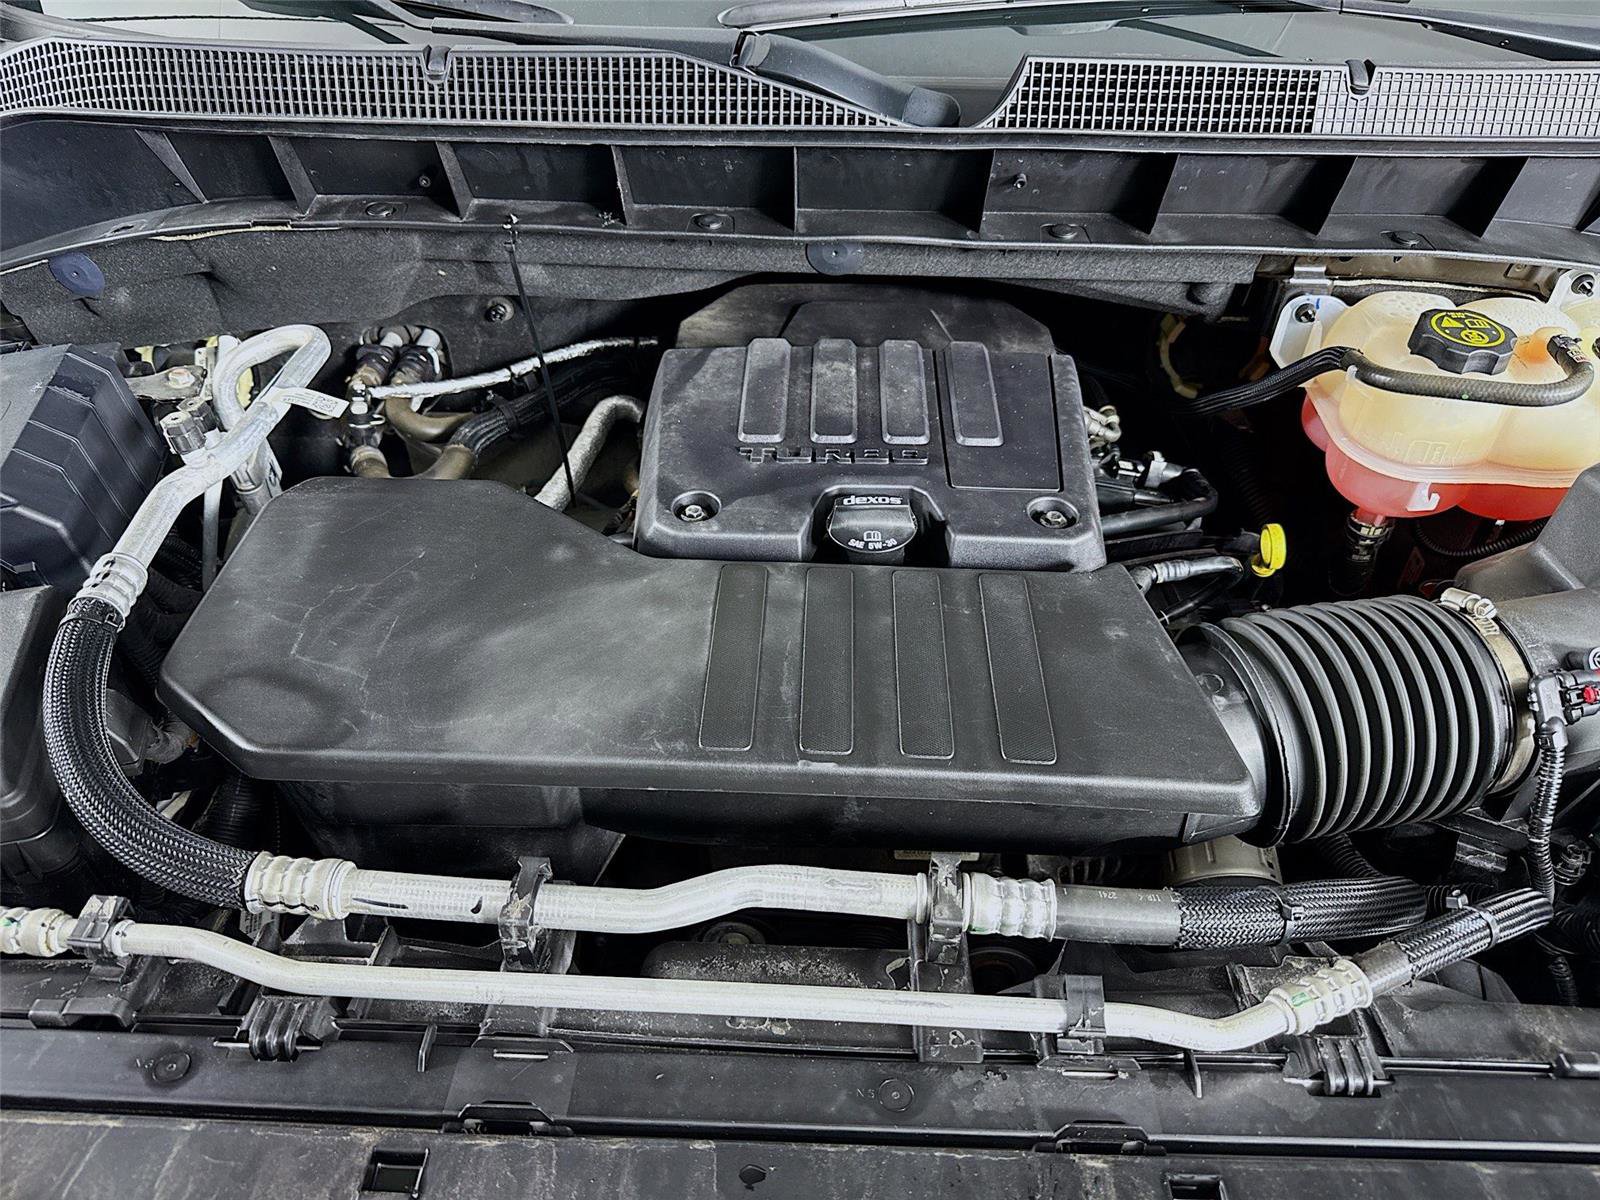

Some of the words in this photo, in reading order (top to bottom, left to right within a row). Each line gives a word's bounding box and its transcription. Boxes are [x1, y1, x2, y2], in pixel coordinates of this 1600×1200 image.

[842, 495, 903, 506] dexos
[847, 538, 866, 549] SAE
[867, 537, 898, 550] 5W-30
